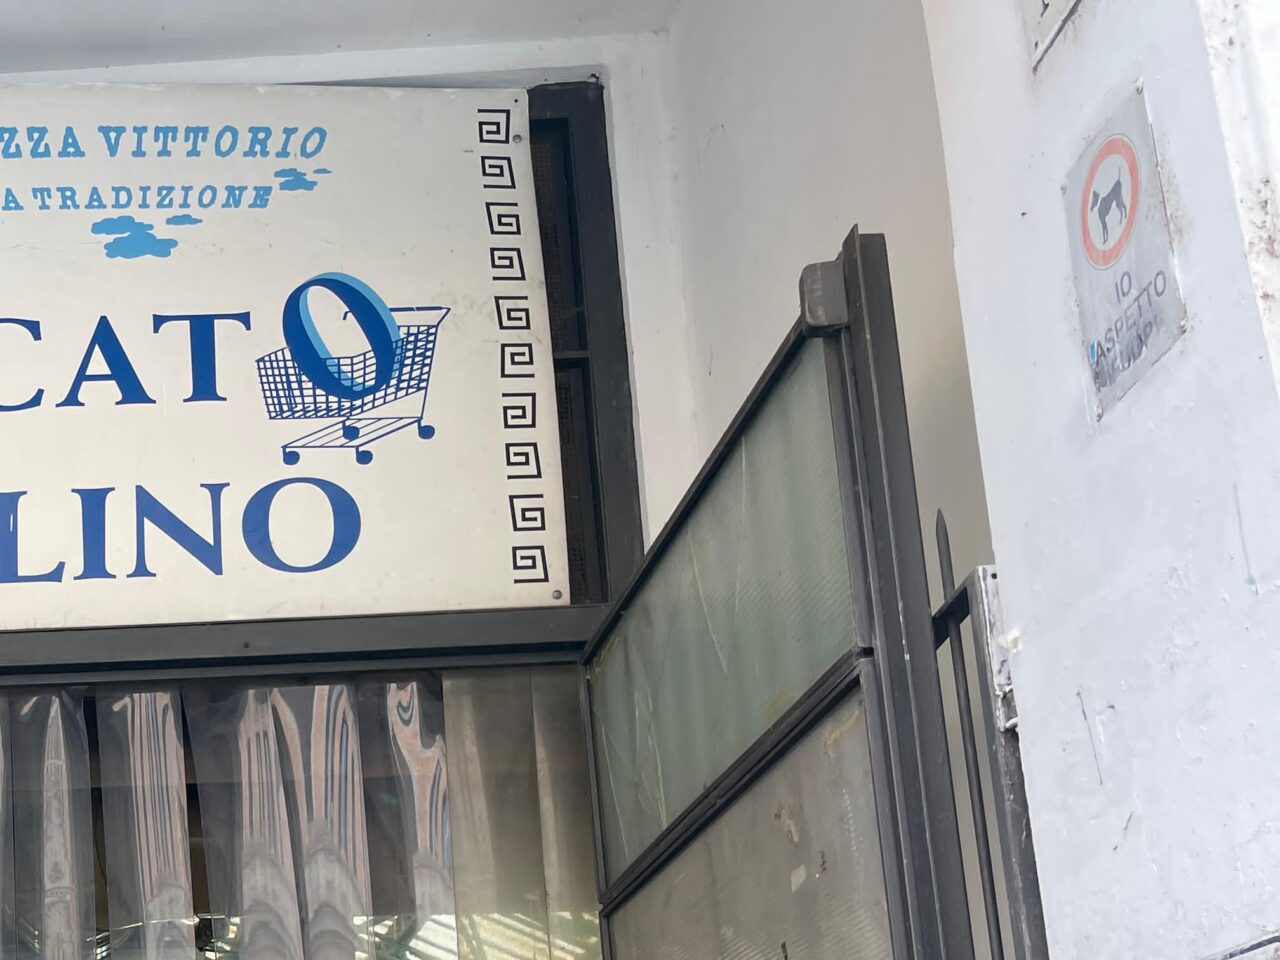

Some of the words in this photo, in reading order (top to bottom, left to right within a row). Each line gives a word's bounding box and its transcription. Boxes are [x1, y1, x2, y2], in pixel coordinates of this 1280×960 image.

[98, 126, 328, 159] VITTORIO
[32, 185, 274, 211] TRADIZIONE
[1115, 271, 1132, 304] IO
[1096, 270, 1167, 367] ASPETTO
